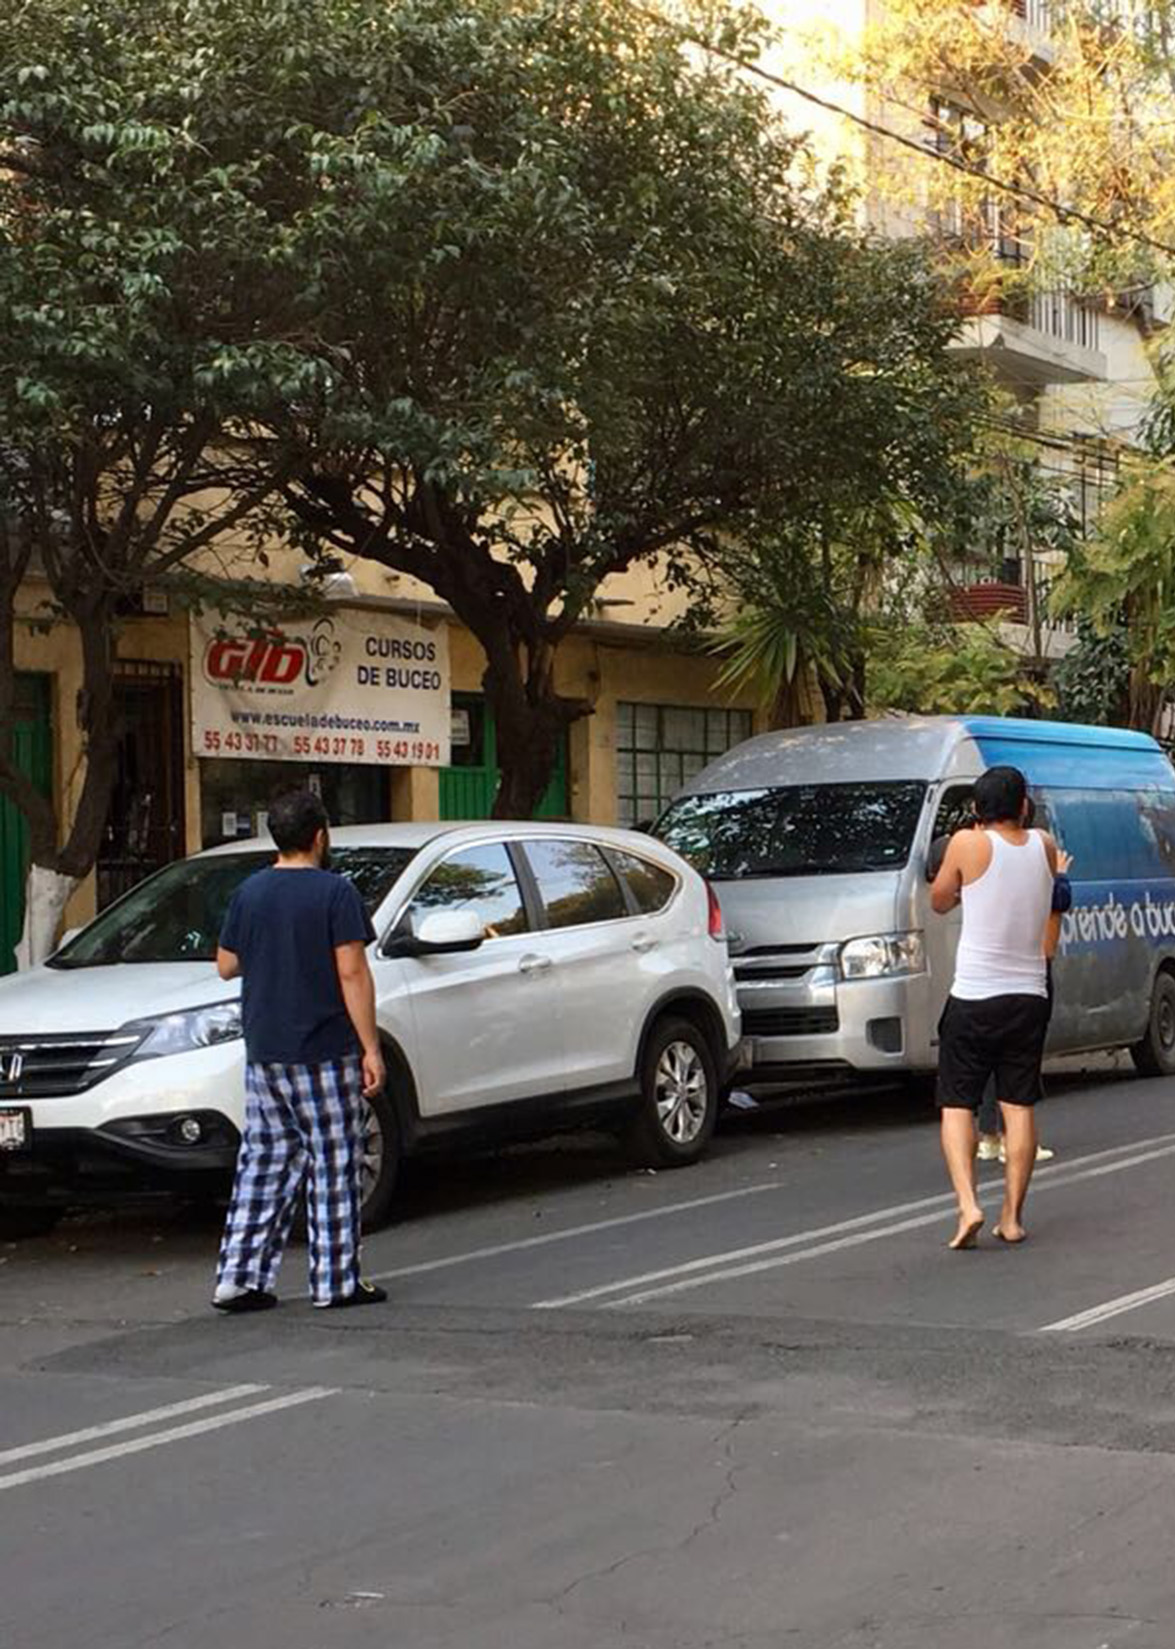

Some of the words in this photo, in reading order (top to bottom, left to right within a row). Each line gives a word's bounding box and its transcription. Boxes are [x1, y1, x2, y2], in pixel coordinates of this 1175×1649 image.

[365, 637, 436, 662] CURSOS
[357, 665, 380, 686] DE
[386, 668, 441, 691] BUCEO
[231, 710, 420, 734] www.escueladebuceo.com.mx
[204, 731, 220, 750] 55
[224, 732, 241, 751] 43
[294, 735, 310, 754] 55
[314, 737, 329, 755] 43
[376, 740, 391, 758] 55
[394, 740, 408, 758] 43
[1060, 892, 1128, 956] prende
[1131, 902, 1144, 938] a
